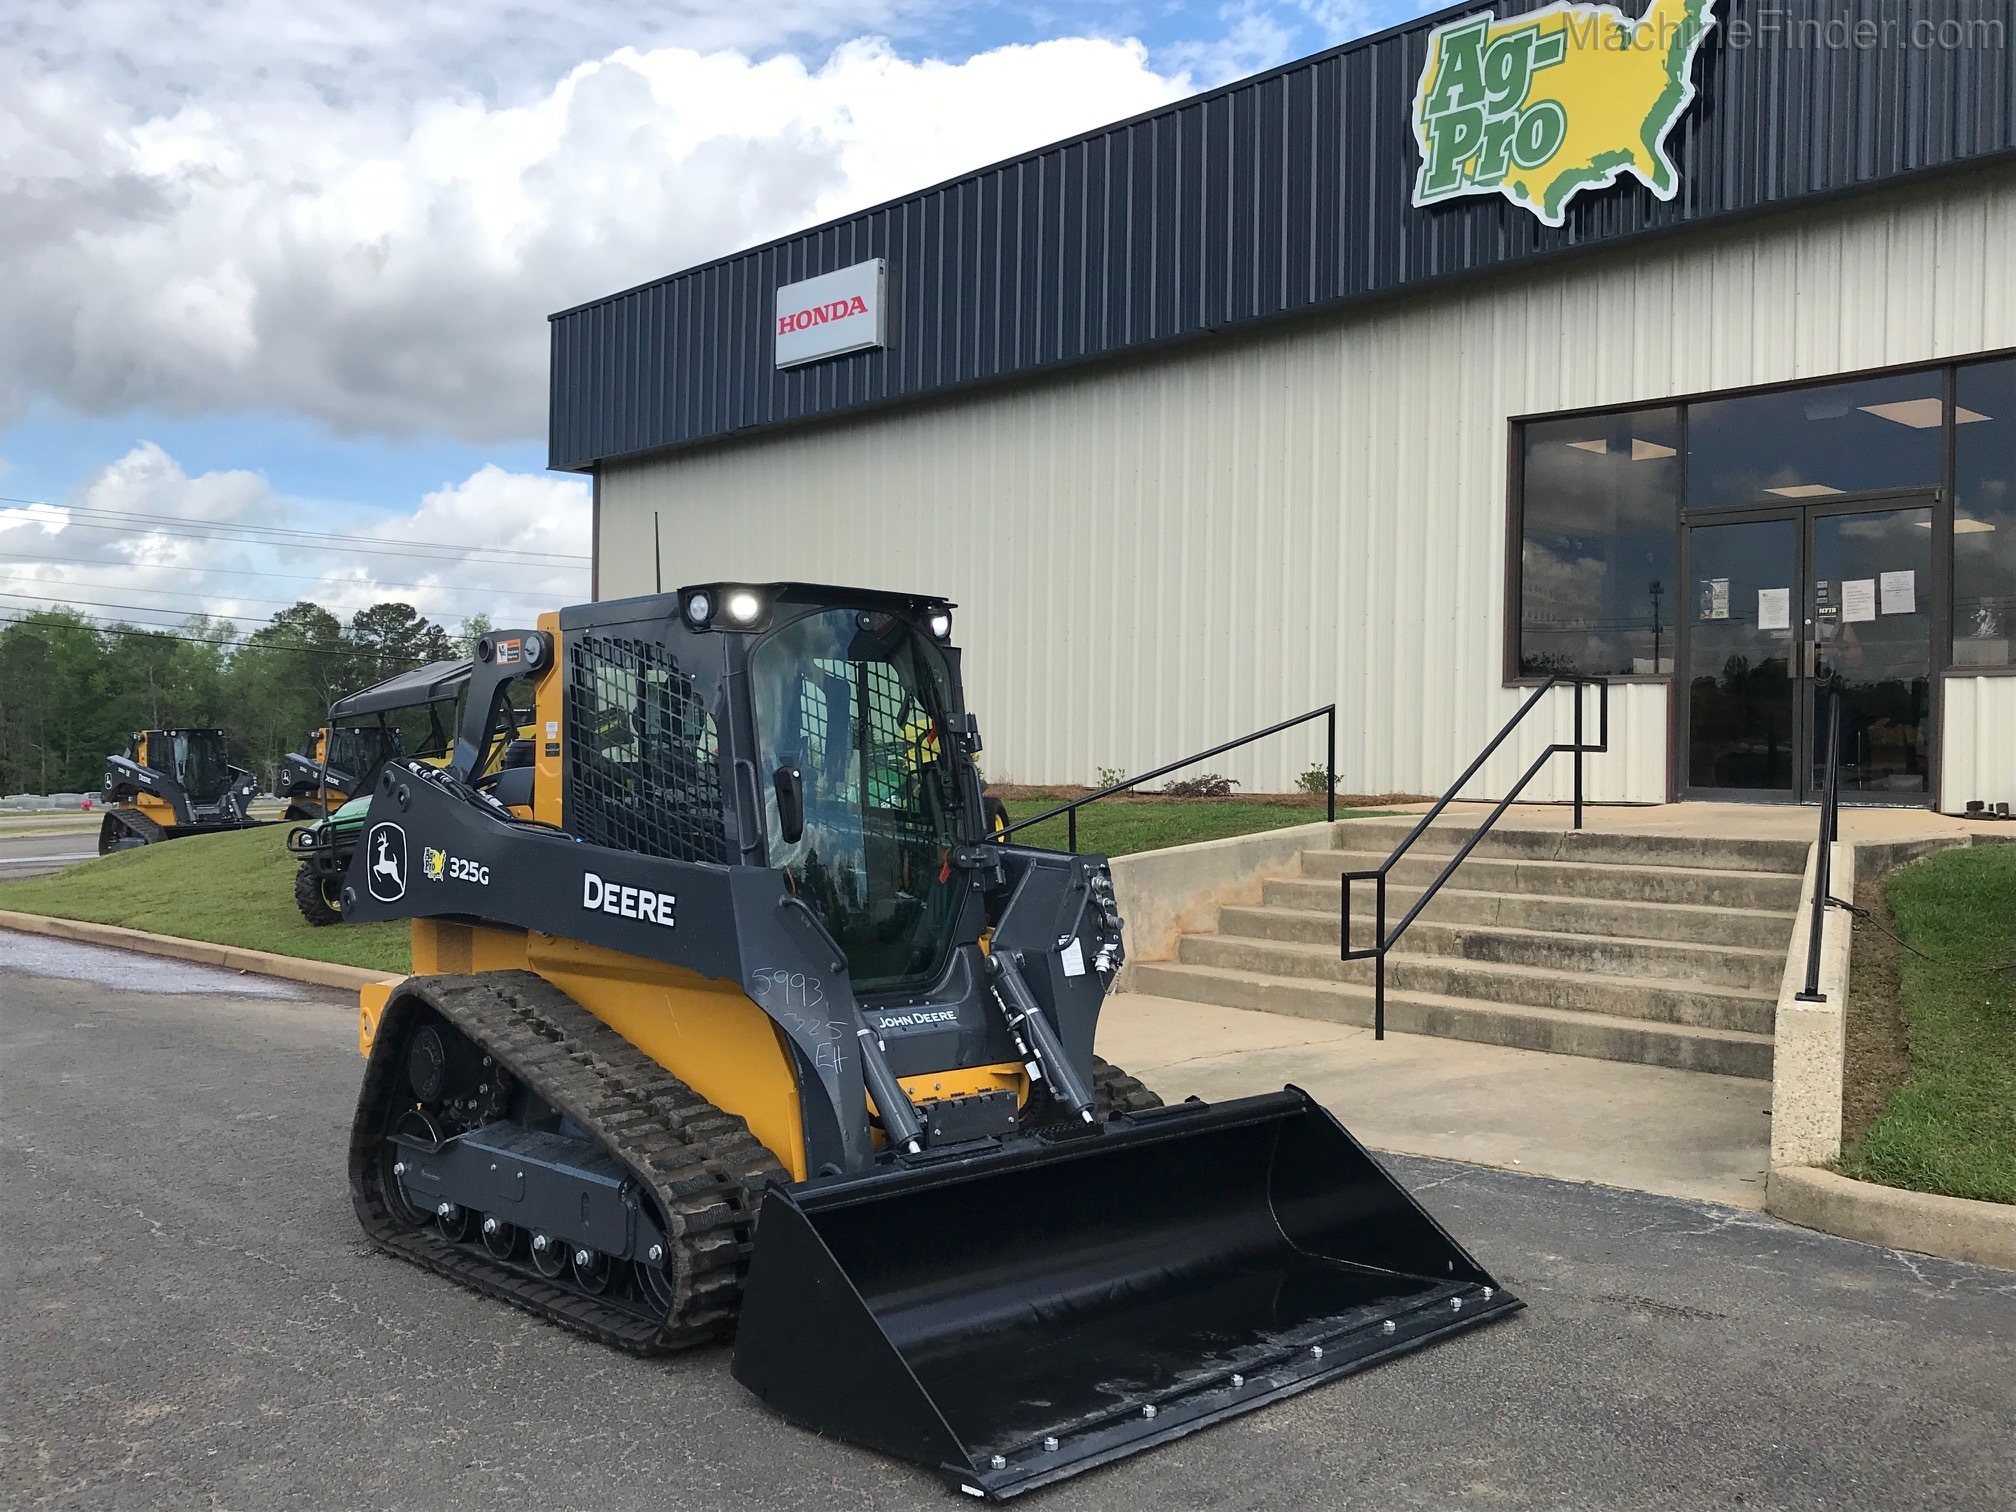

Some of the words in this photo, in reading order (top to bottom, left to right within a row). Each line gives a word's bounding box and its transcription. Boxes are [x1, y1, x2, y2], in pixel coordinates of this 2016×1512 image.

[1425, 22, 1566, 118] Ag-
[1425, 105, 1564, 193] Pro
[778, 295, 868, 335] HONDA
[449, 857, 490, 886] 325G
[583, 872, 675, 927] DEERE
[751, 967, 823, 1007] 5993
[783, 1012, 848, 1040] 325
[879, 1016, 914, 1029] JOHN
[911, 1010, 957, 1024] DEERE
[815, 1042, 848, 1075] EH
